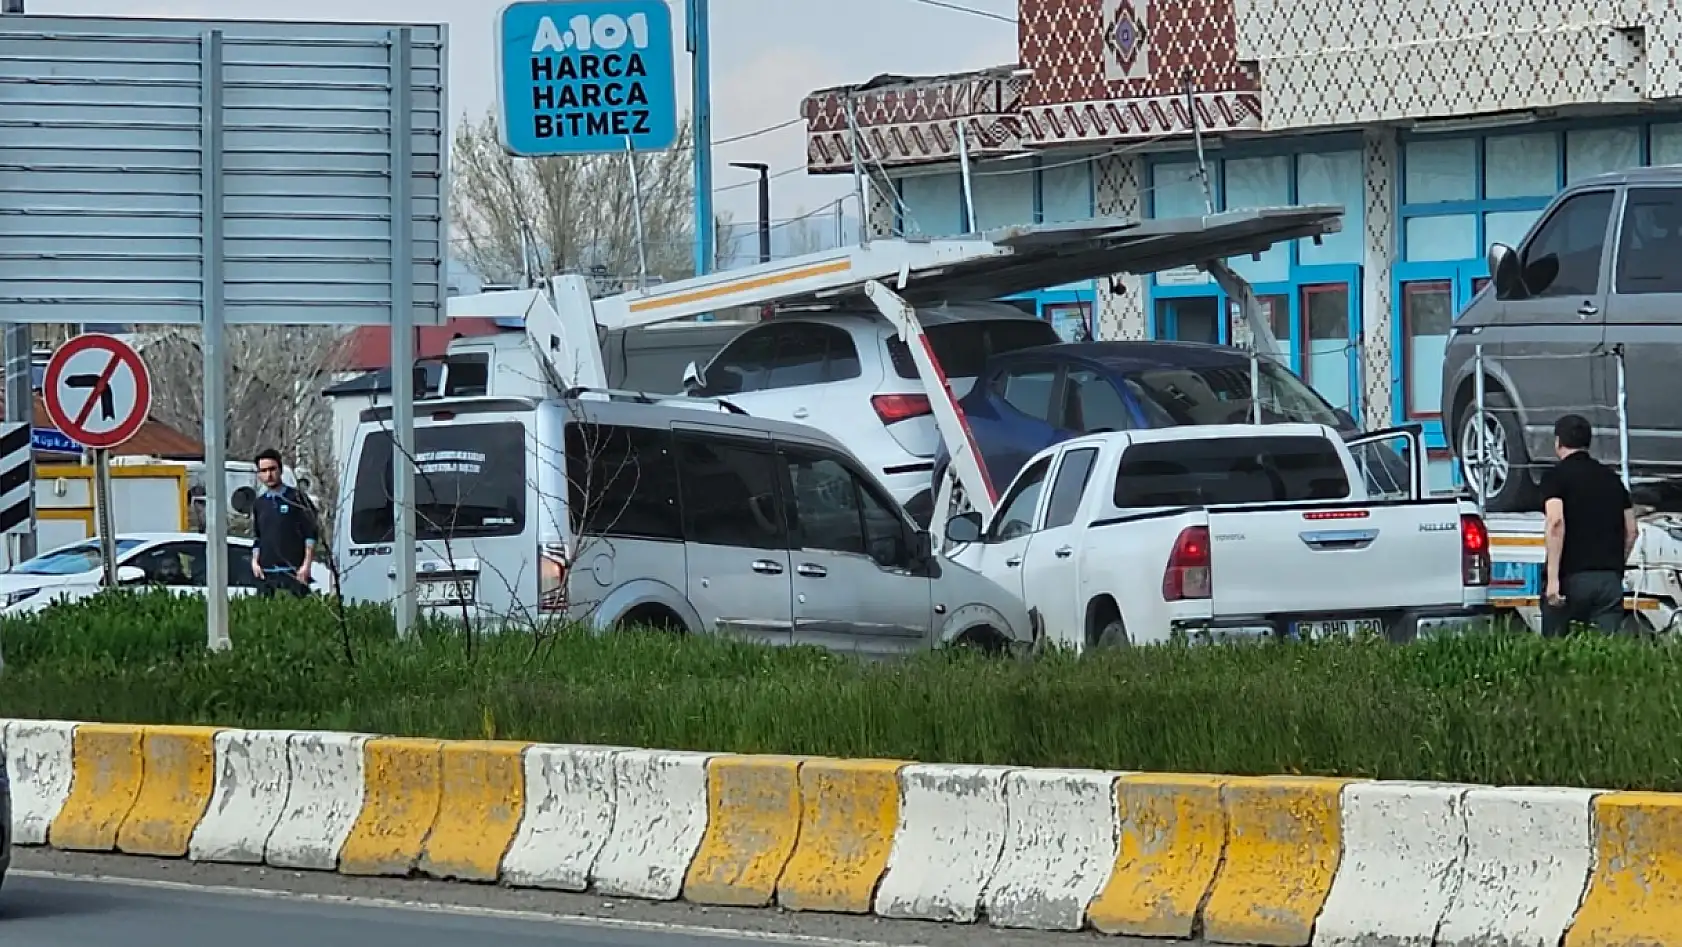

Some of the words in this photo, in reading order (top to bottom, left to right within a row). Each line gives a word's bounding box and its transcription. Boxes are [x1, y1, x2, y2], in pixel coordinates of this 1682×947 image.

[531, 53, 647, 81] HARCA
[533, 82, 648, 109] HARCA
[1214, 533, 1247, 542] TOYOTA
